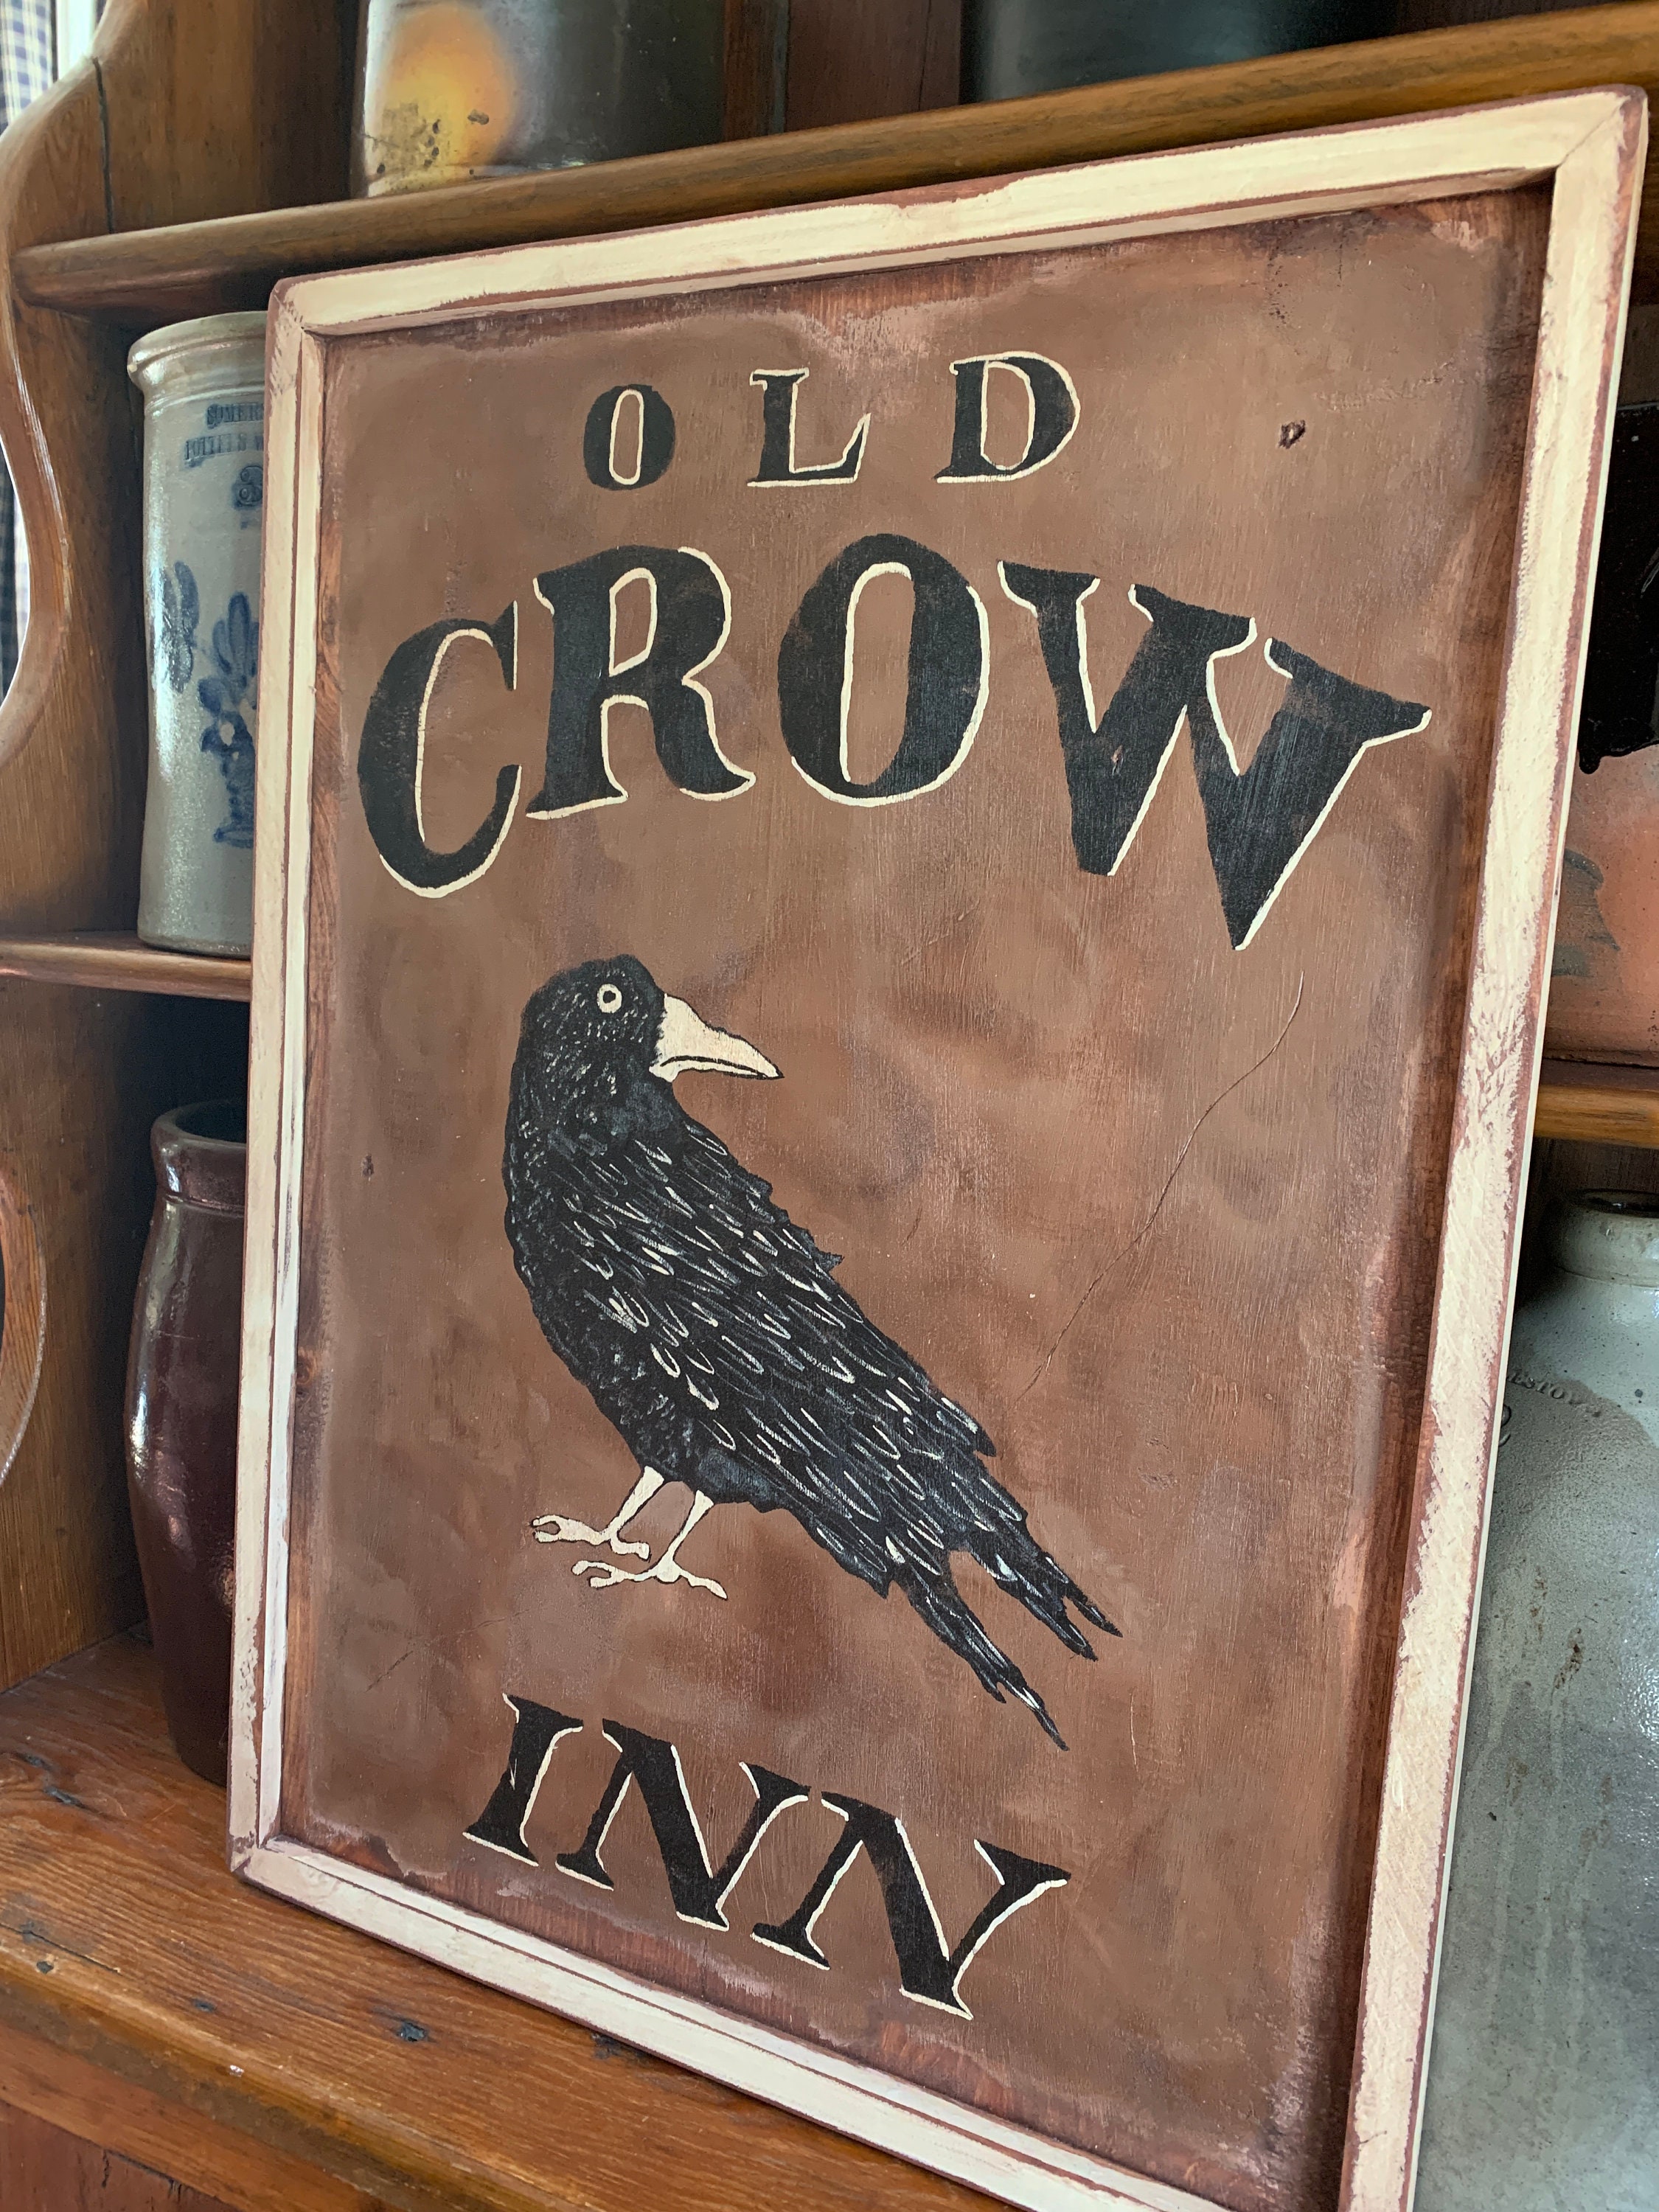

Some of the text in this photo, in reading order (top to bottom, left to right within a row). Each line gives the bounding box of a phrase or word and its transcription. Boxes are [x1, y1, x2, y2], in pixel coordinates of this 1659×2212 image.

[583, 351, 1080, 490] OLD
[358, 534, 1432, 951] CROW
[463, 1693, 1071, 2021] INN
